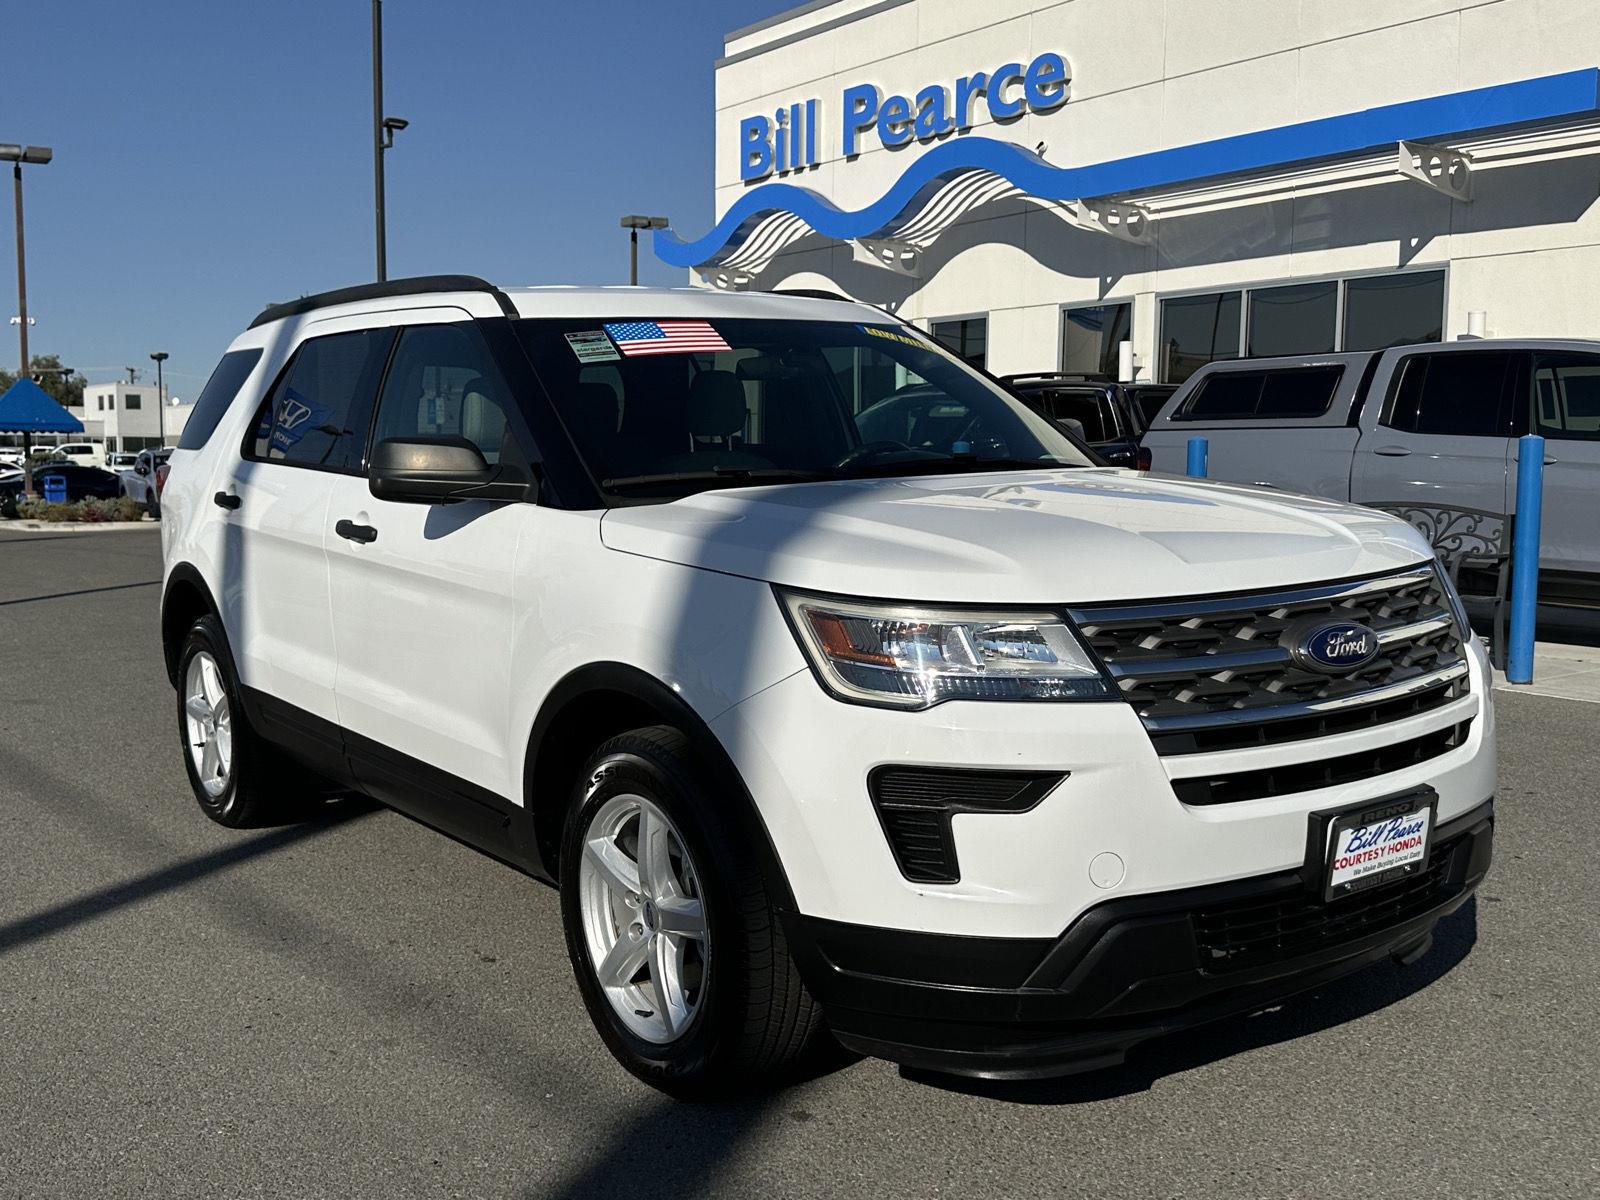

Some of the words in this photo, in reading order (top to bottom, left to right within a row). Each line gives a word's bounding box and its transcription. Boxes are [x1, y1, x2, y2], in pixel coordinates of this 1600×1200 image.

[740, 98, 821, 181] Bill
[843, 52, 1071, 156] Pearce
[1326, 632, 1368, 658] Ford
[1333, 846, 1386, 871] COURTESY
[1387, 835, 1422, 855] HONDA
[1345, 822, 1387, 854] Bill
[1383, 816, 1424, 842] Pearce
[1362, 864, 1376, 873] Make
